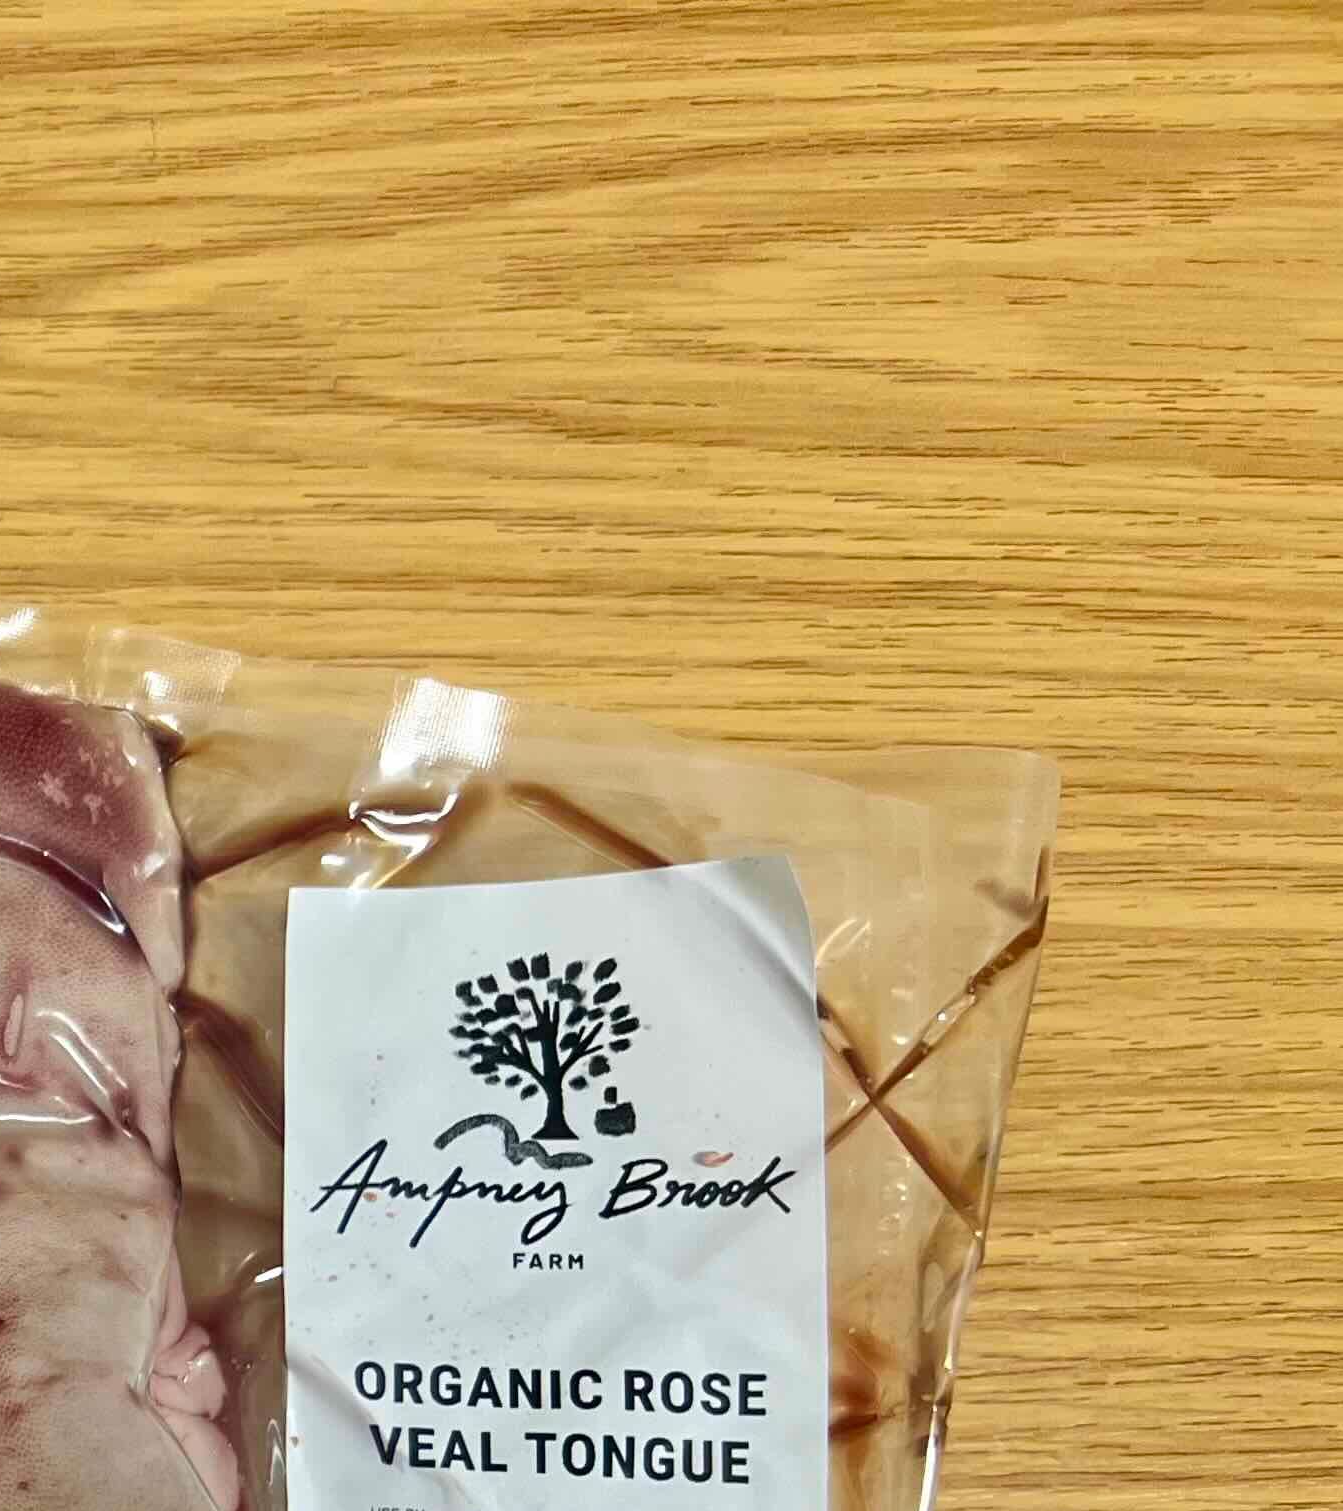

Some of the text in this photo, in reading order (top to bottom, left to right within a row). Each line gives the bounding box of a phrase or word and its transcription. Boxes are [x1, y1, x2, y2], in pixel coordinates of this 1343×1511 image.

[309, 1138, 799, 1249] Ampney Brook
[513, 1252, 585, 1270] FARM
[354, 1360, 768, 1417] ORGANIC ROSE
[368, 1423, 751, 1484] VEAL TONGUE
